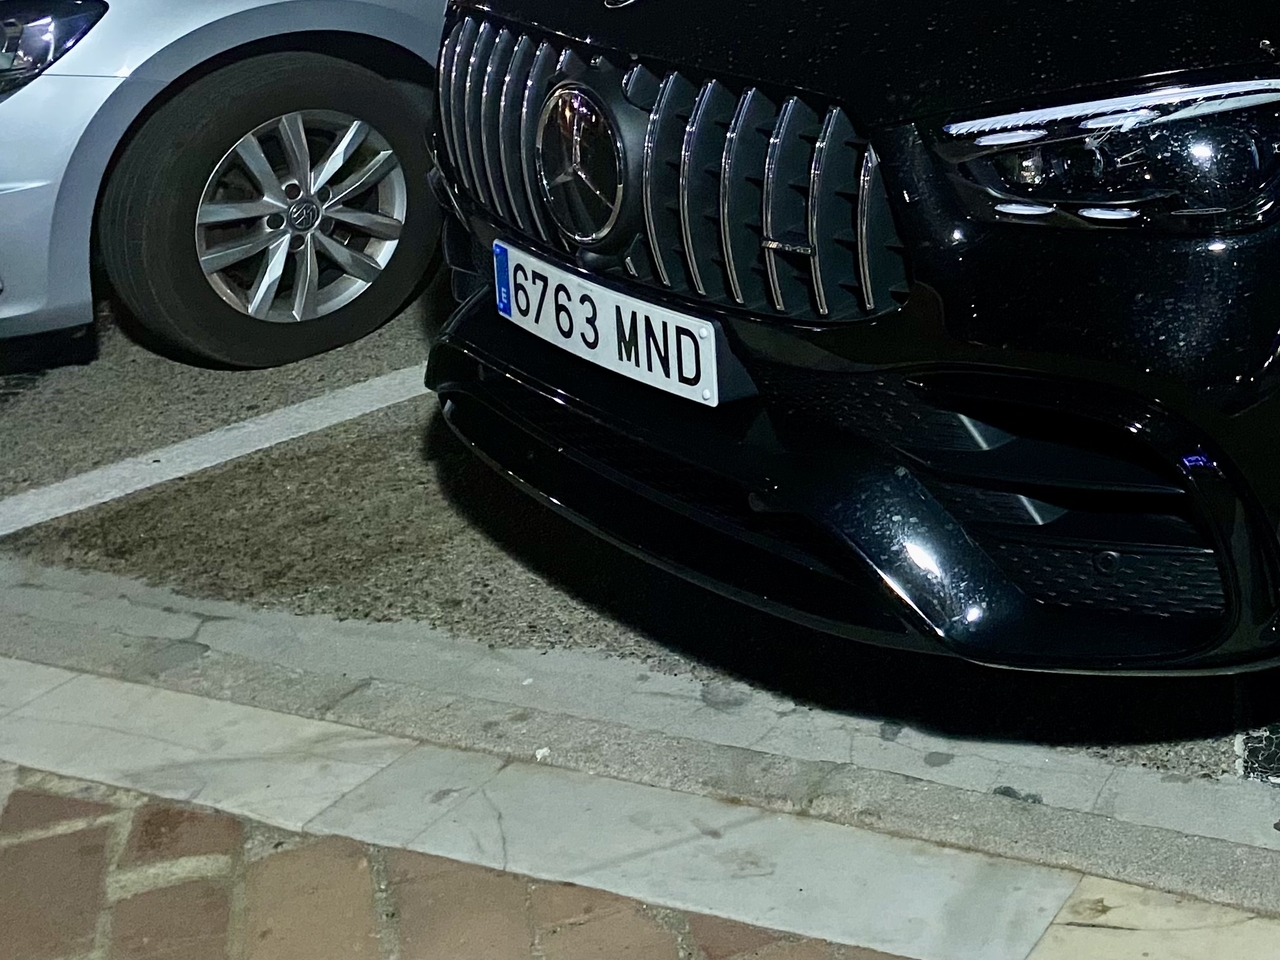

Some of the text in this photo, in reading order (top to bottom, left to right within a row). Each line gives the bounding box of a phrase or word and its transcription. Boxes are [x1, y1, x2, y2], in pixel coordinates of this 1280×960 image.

[501, 263, 702, 387] E 6763 MND
